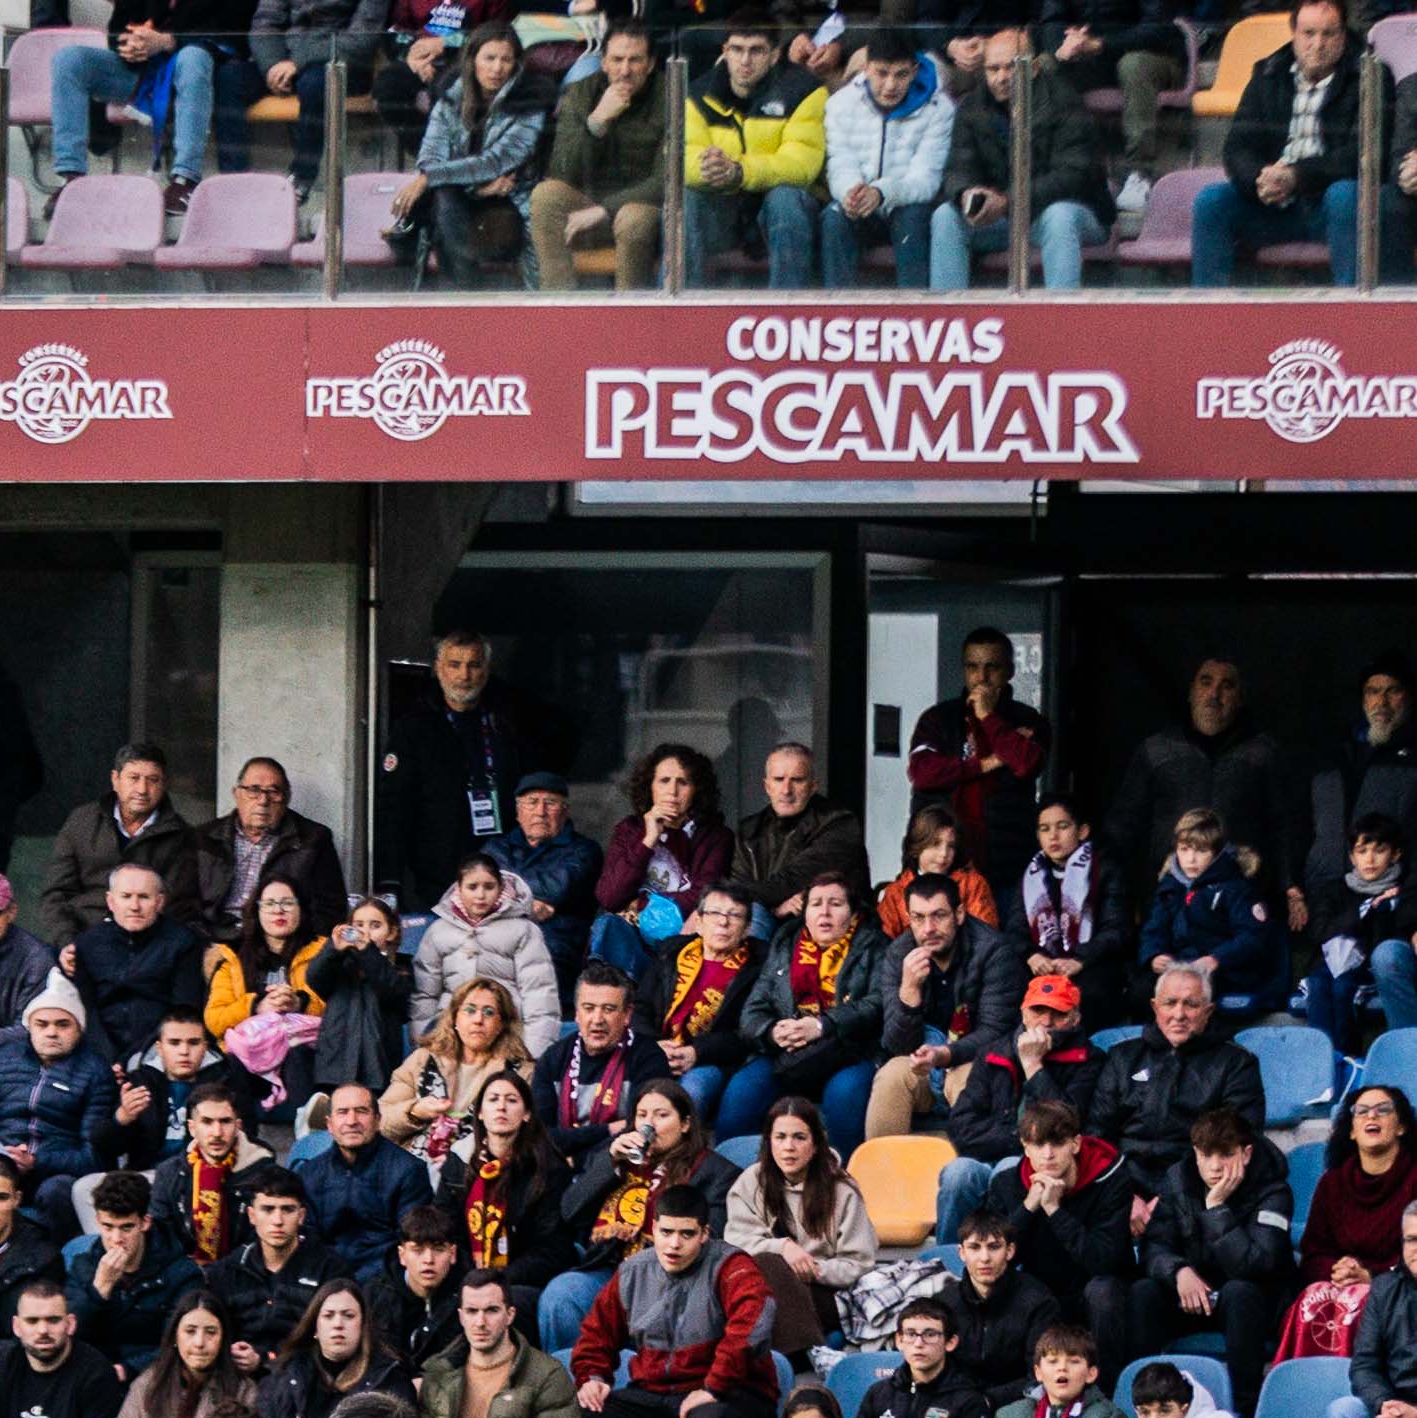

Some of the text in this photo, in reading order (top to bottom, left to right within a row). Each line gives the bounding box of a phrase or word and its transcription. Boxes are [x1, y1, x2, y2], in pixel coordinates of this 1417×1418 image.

[725, 315, 1005, 366] CONSERVAS
[306, 375, 532, 418] PESCAMAR
[585, 368, 1141, 464] PESCAMAR
[1196, 374, 1417, 421] PESCAMAR
